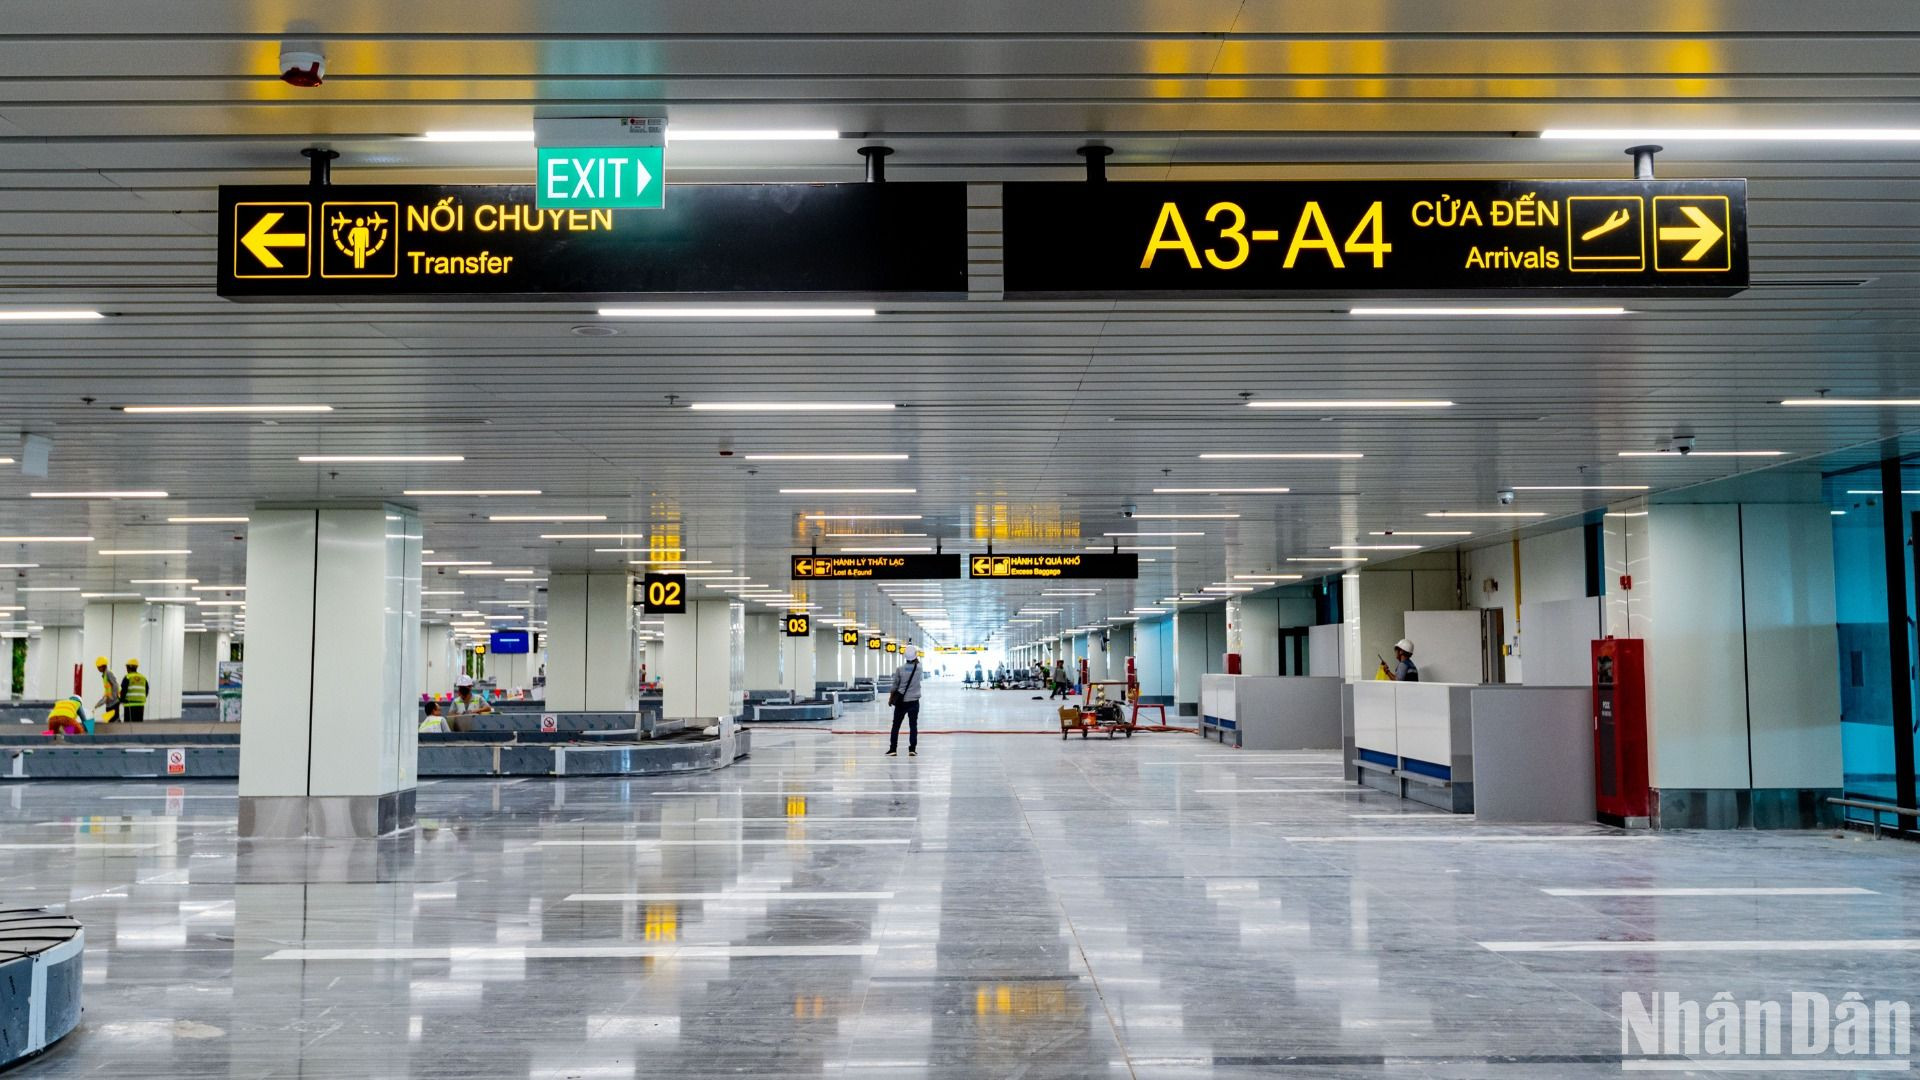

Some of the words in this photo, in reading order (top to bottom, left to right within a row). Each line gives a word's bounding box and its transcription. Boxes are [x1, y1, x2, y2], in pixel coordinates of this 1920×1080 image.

[547, 158, 629, 199] EXIT
[407, 196, 464, 232] NỐI
[1411, 194, 1484, 227] CỬA
[1490, 192, 1559, 227] ĐẾN
[1140, 201, 1392, 270] A3-A4
[407, 251, 514, 274] Transfer
[1465, 246, 1560, 269] Arrivals
[1011, 568, 1033, 576] Excess
[1034, 568, 1061, 577] Baggage
[649, 582, 681, 606] 02
[788, 618, 807, 633] 03
[844, 632, 858, 643] 04
